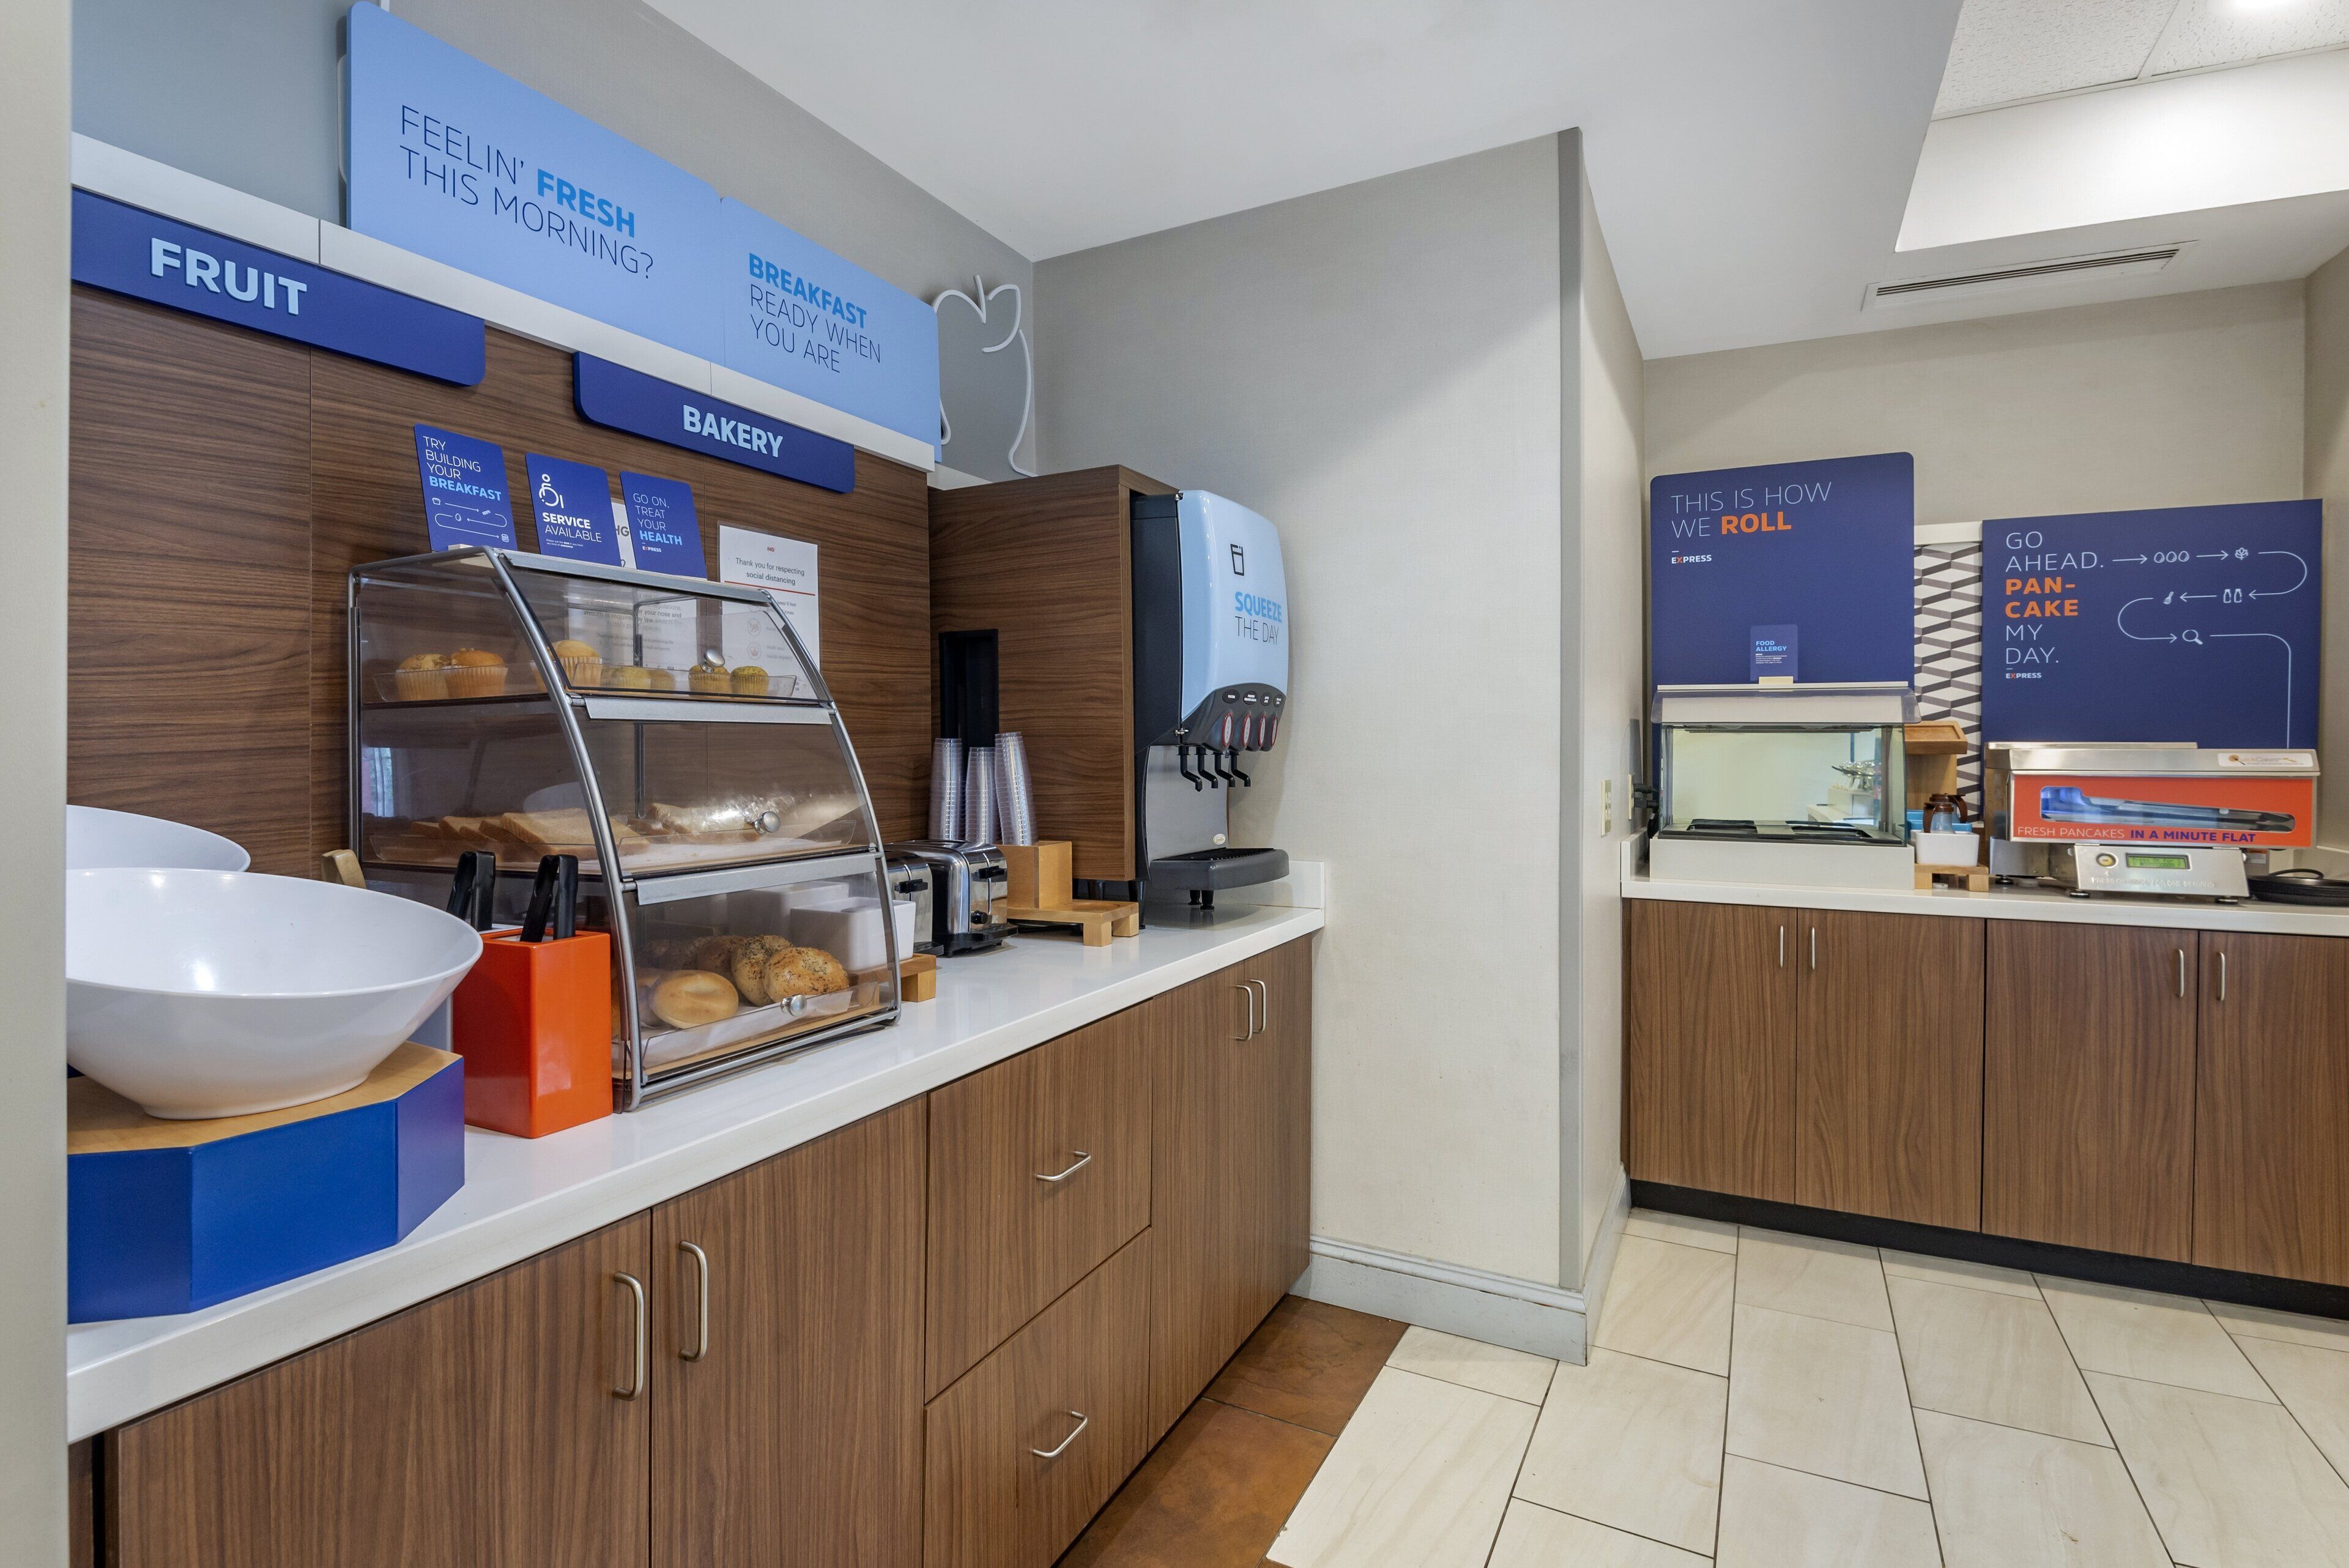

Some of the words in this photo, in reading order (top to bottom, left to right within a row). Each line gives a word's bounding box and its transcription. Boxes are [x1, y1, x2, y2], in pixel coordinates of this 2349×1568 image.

[402, 105, 524, 185] FEELIN'
[537, 168, 635, 239] FRESH
[399, 145, 478, 206] THIS
[494, 187, 653, 279] MORNING?
[151, 237, 307, 316] FRUIT
[749, 252, 867, 329] BREAKFAST
[751, 284, 818, 333] READY
[826, 318, 880, 363] WHEN
[750, 314, 795, 353] YOU
[804, 340, 840, 373] ARE
[683, 404, 784, 458] BAKERY
[423, 436, 446, 451] TRY
[426, 449, 481, 472] BUILDING
[427, 462, 461, 480] YOUR
[429, 476, 502, 501] BREAKFAST
[1671, 491, 1723, 513] THIS
[1735, 488, 1754, 508] IS
[1765, 481, 1831, 506] HOW
[633, 493, 648, 504] GO
[651, 496, 669, 508] ON,
[542, 512, 591, 529] SERVICE
[635, 505, 665, 519] TREAT
[615, 525, 629, 537] HG
[637, 518, 666, 531] YOUR
[1671, 517, 1710, 538] WE
[1721, 511, 1792, 535] ROLL
[545, 525, 602, 543] AVAILABLE
[639, 530, 682, 545] HEALTH
[2006, 531, 2043, 549] GO
[736, 557, 753, 567] Thank
[776, 565, 804, 576] respecting
[1671, 554, 1712, 563] EXPRESS
[2005, 552, 2104, 573] AHEAD.
[765, 574, 795, 585] distancing
[2006, 577, 2076, 595] PAN-
[1235, 591, 1282, 623] SQUEEZE
[2005, 600, 2078, 618] CAKE
[1235, 615, 1258, 641] THE
[1263, 622, 1279, 645] DAY
[2006, 624, 2043, 641] MY
[2006, 647, 2059, 664] DAY.
[2017, 827, 2055, 836] FRESH
[2060, 828, 2124, 838] PANCAKES
[2131, 830, 2144, 839] IN
[2149, 830, 2159, 839] A
[2164, 831, 2217, 841] MINUTE
[2222, 833, 2256, 842] FLAT
